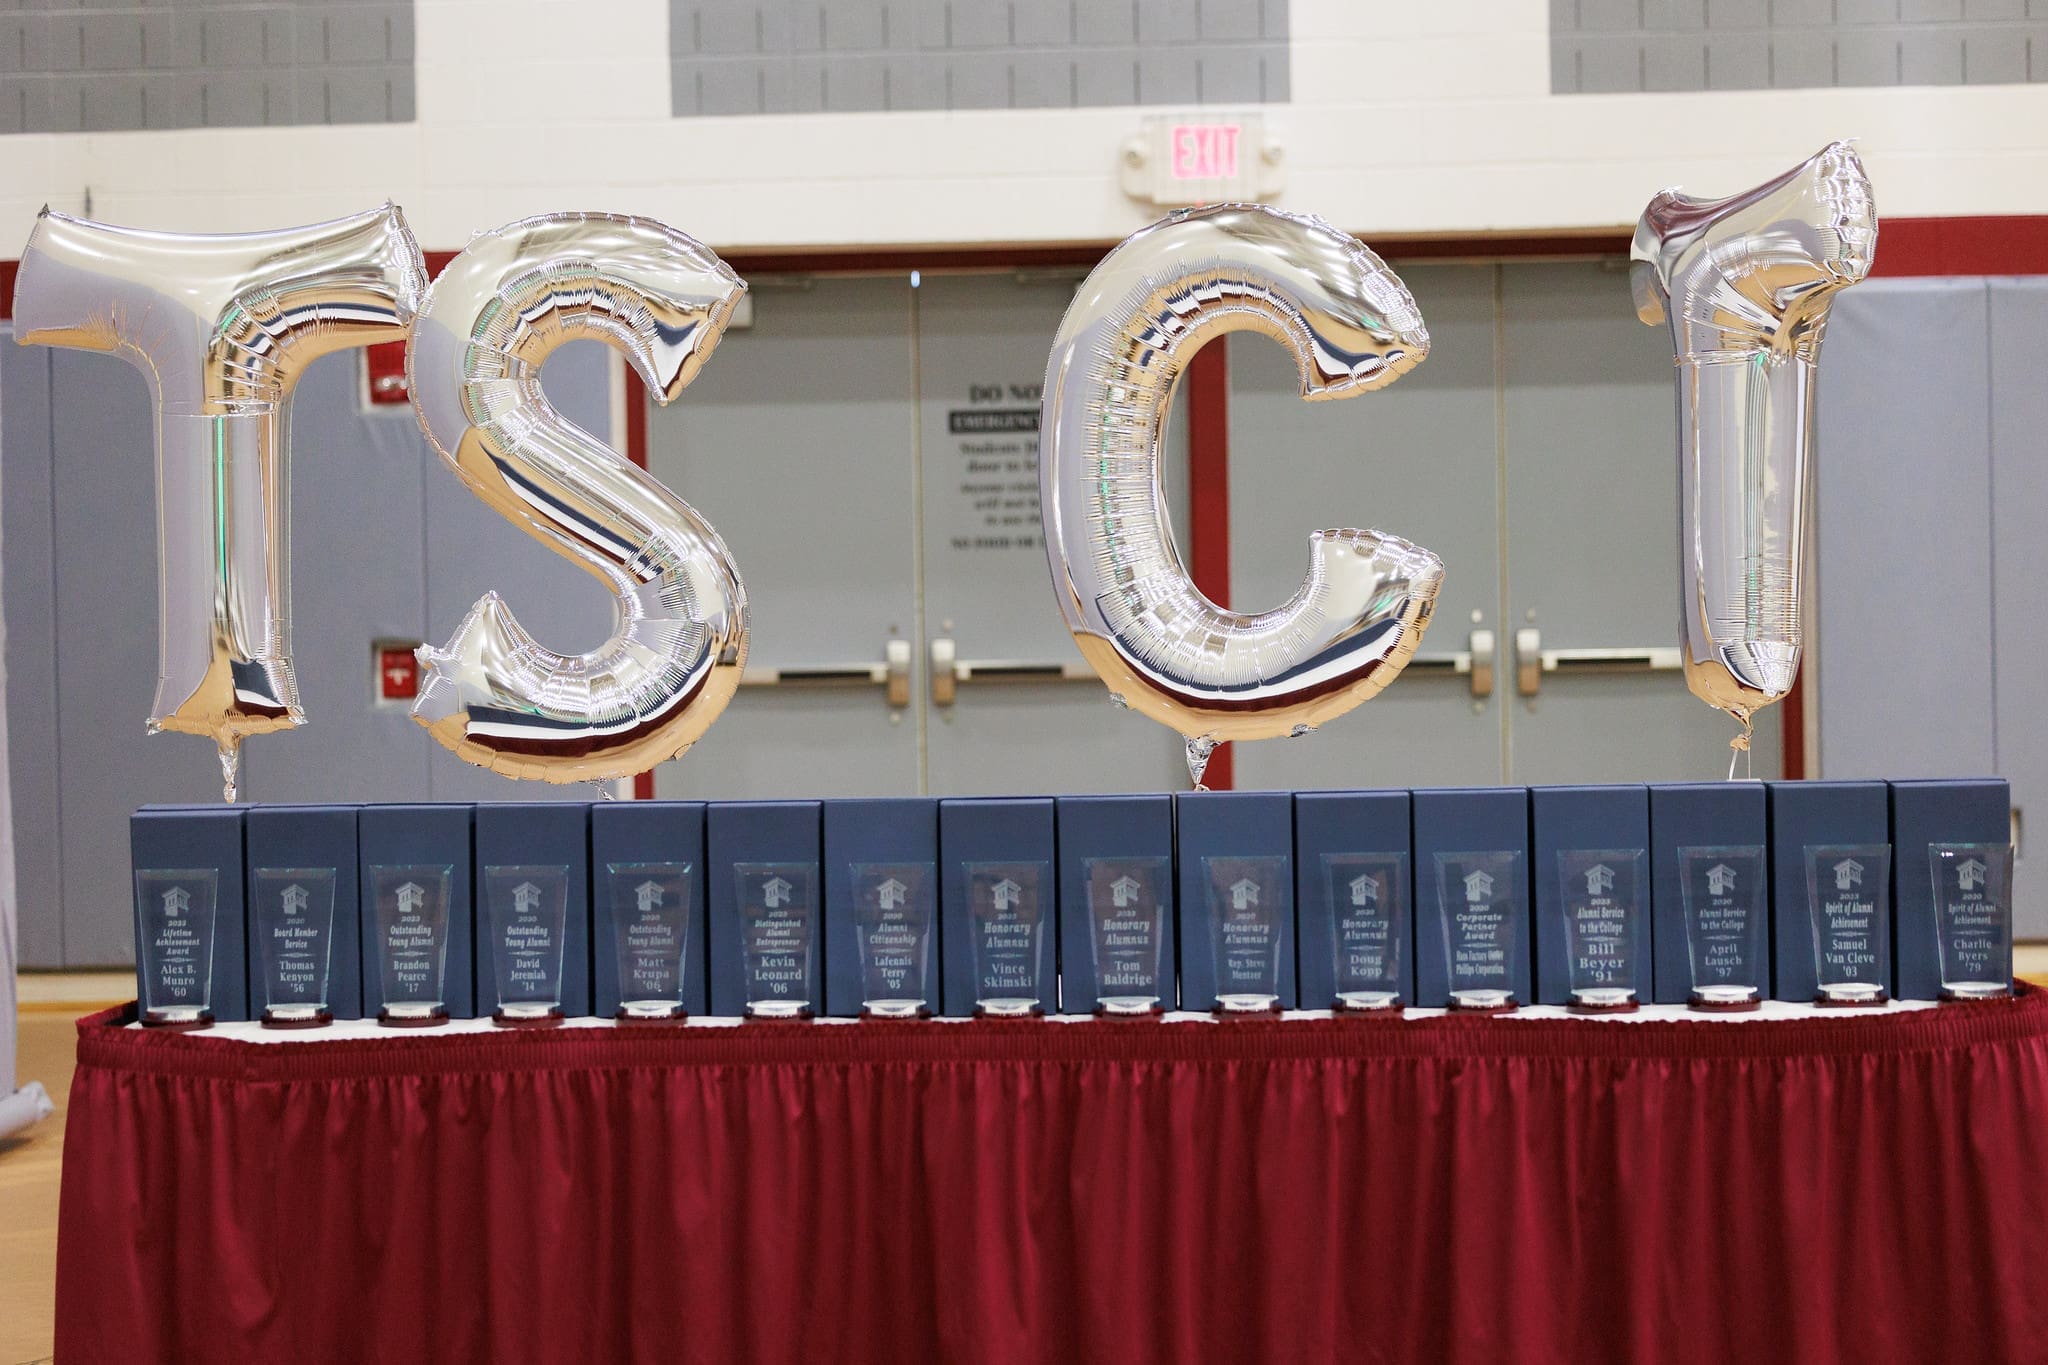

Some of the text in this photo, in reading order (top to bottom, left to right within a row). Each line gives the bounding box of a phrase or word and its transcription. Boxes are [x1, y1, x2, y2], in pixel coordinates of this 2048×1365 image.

[1174, 126, 1239, 178] EXIT
[1577, 907, 1625, 919] Alumni Service
[1700, 908, 1746, 917] Alumni Service
[1825, 902, 1873, 916] Spirit of Alumni
[1949, 903, 1996, 915] Spirit of Alumni
[1456, 914, 1502, 922] Corporate
[1954, 915, 1991, 925] Achievement
[755, 919, 800, 928] Distinguished
[878, 923, 907, 932] Alumni
[984, 922, 1031, 935] Honorary
[1104, 919, 1150, 932] Honorary
[1223, 923, 1269, 934] Honorary
[1343, 919, 1388, 930] Honorary
[1461, 923, 1497, 931] Partner
[1579, 921, 1623, 935] to the College
[1701, 920, 1745, 932] to the College
[1831, 918, 1868, 929] Achievement
[163, 929, 192, 939] Lifetime
[274, 928, 318, 937] Board Member
[390, 925, 432, 936] Outstanding
[507, 926, 548, 937] Outstanding
[630, 925, 671, 935] Outstanding
[1344, 930, 1388, 940] Alumnus
[870, 933, 917, 945] Citizenship
[1106, 934, 1148, 945] Alumnus
[1225, 934, 1268, 944] Alumnus
[1465, 932, 1495, 940] Award
[285, 940, 308, 949] Service
[388, 936, 434, 948] Young Alumni
[505, 937, 550, 949] Young Alumni
[628, 937, 674, 947] Young Alumni
[756, 938, 800, 947] Entrepreneur
[986, 937, 1029, 948] Alumnus
[1832, 939, 1867, 950] Samuel
[1954, 940, 1992, 949] Charlie
[1588, 944, 1615, 954] Bill
[1709, 944, 1737, 956] April
[761, 956, 795, 967] Kevin
[875, 956, 912, 966] Lafennis
[1351, 955, 1382, 965] Doug
[1705, 956, 1742, 966] Lausch
[1826, 953, 1875, 963] Van Cleve
[1959, 952, 1988, 962] Byers
[280, 961, 315, 970] Thomas
[394, 961, 430, 970] Brandon
[516, 959, 540, 969] David
[638, 959, 664, 967] Matt
[1115, 960, 1140, 971] Tom
[1580, 958, 1625, 970] Beyer
[161, 965, 197, 974] Alex B.
[881, 968, 906, 979] Terry
[992, 963, 1025, 974] Vince
[1351, 966, 1382, 977] Kopp
[1716, 968, 1732, 977] '97
[1843, 966, 1858, 977] '03
[280, 972, 314, 982] Kenyon
[398, 972, 427, 981] Pearce
[511, 971, 546, 981] Jeremiah
[633, 969, 669, 980] Krupa
[755, 969, 802, 980] Leonard
[1591, 971, 1613, 982] '91
[163, 976, 195, 985] Munro
[984, 977, 1032, 987] Skimski
[1104, 974, 1152, 986] Baldrige
[171, 987, 186, 996] '60
[291, 984, 304, 993] '56
[406, 983, 419, 992] '17
[523, 982, 535, 991] '14
[770, 983, 788, 993] '06
